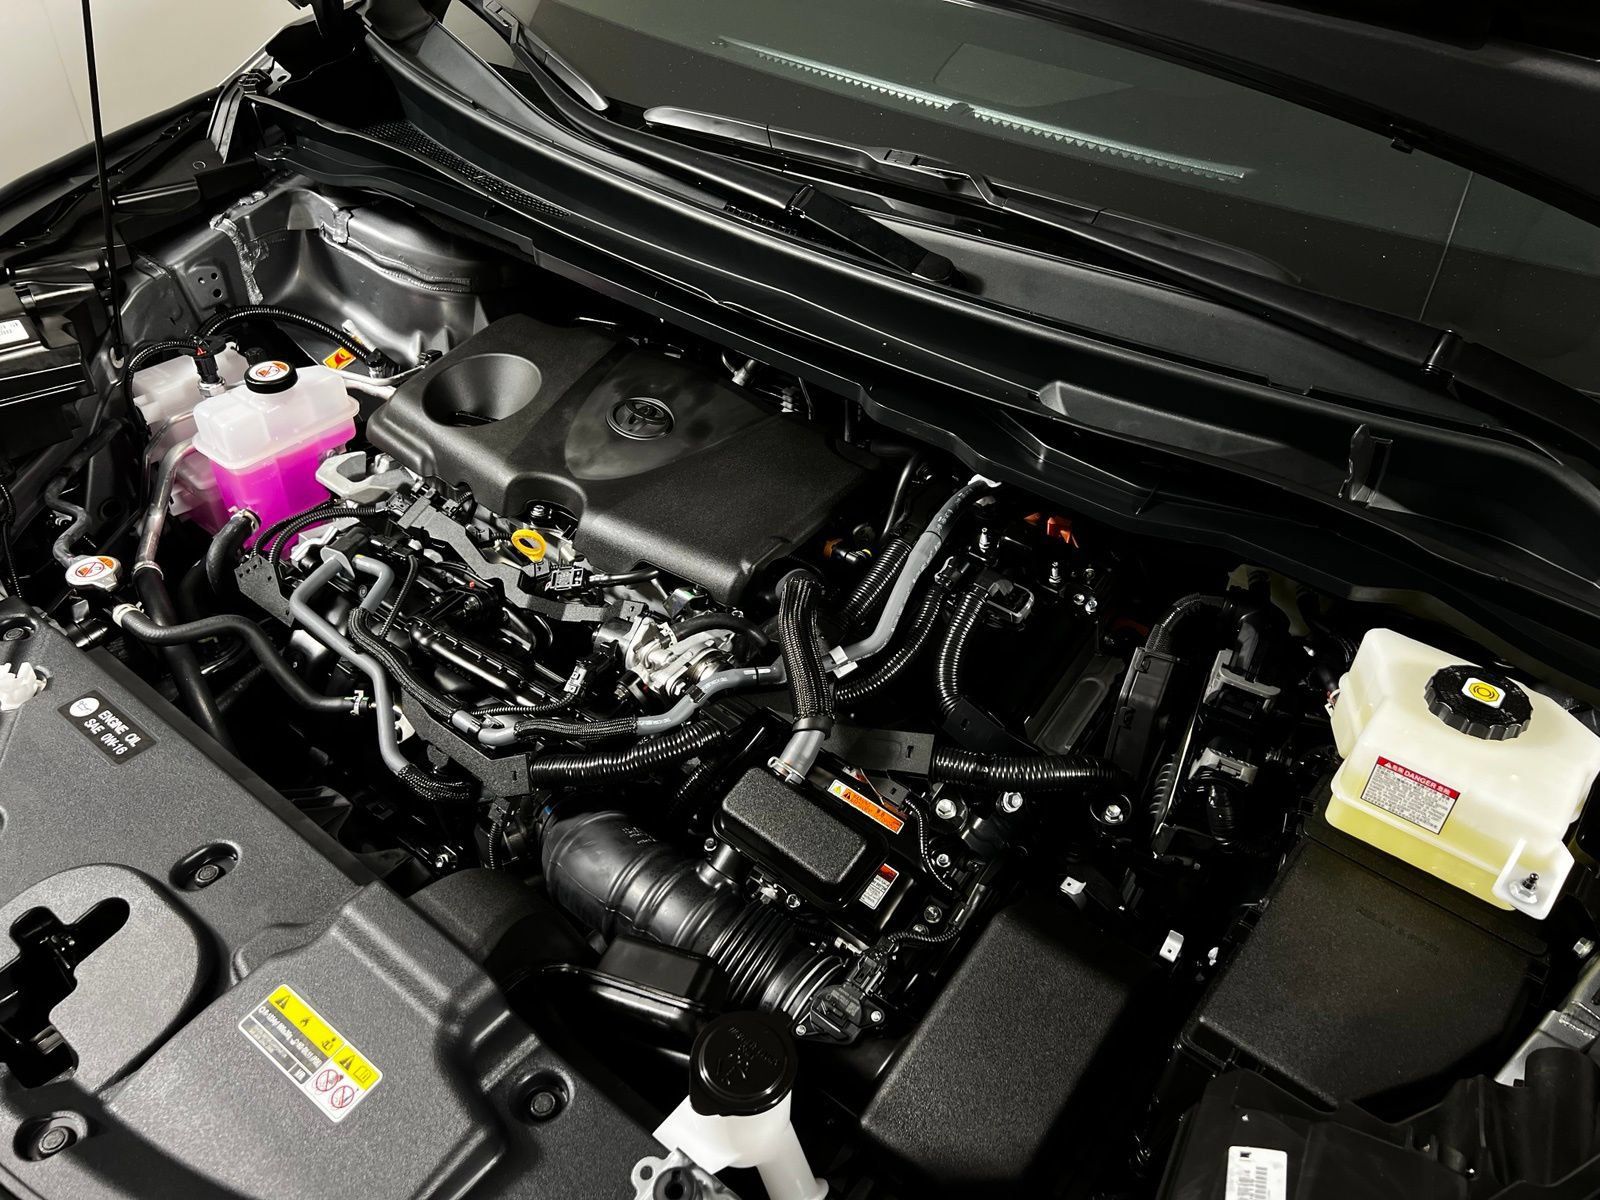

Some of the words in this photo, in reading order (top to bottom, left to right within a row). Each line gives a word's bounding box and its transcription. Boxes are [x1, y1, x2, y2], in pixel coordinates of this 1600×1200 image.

[84, 718, 105, 735] SAE
[100, 732, 128, 755] 0W-16
[98, 709, 129, 735] ENGINE
[124, 732, 141, 748] OIL
[1403, 769, 1437, 789] DANGER
